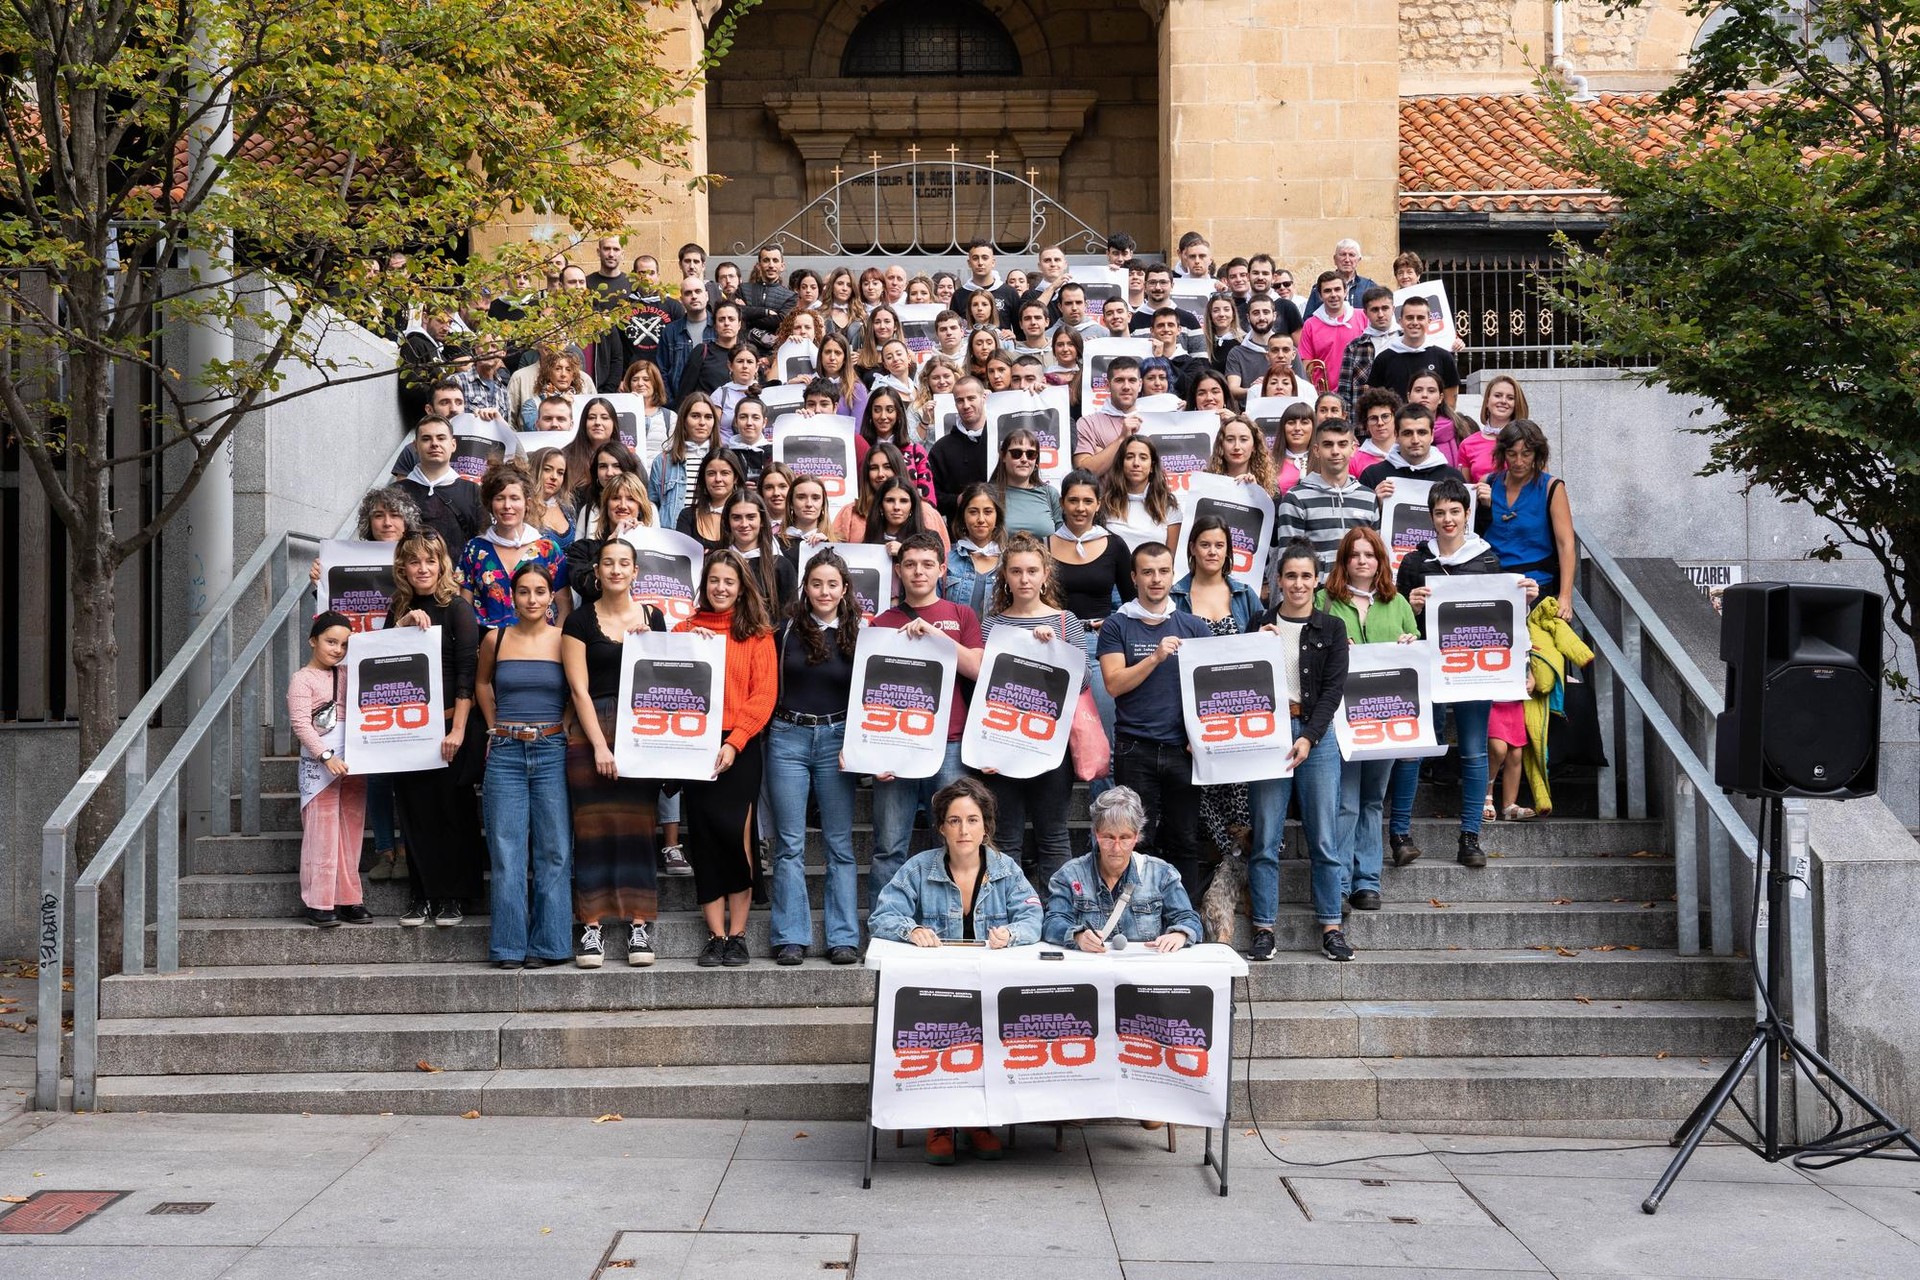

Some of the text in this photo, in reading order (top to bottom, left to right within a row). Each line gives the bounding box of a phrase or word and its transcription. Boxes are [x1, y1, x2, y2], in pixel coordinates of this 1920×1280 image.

[343, 590, 382, 598] GREBA
[331, 604, 387, 612] OROKORR
[1453, 625, 1497, 634] GREBA
[1442, 632, 1509, 641] FEMINISTA
[1441, 639, 1510, 648] OROKORRA
[1441, 645, 1511, 673] 30
[373, 681, 414, 691] GREBA
[648, 687, 693, 696] GREBA
[879, 683, 923, 695] GREBA
[1004, 682, 1048, 699] GREBA
[361, 687, 426, 699] FEMINISTA
[635, 693, 706, 703] FEMINISTA
[866, 688, 935, 703] FEMINISTA
[990, 685, 1058, 710] FEMINISTA
[1211, 689, 1257, 700] GREBA
[360, 695, 427, 706] OROKORRA
[634, 700, 706, 711] OROKORRA
[864, 696, 935, 711] OROKORRA
[988, 693, 1057, 717] OROKORRA
[1199, 695, 1271, 708] FEMINISTA
[1359, 695, 1403, 706] GREBA
[1200, 702, 1272, 716] OROKORRA
[1348, 701, 1415, 714] FEMINISTA
[359, 701, 430, 732] 30
[861, 703, 935, 736] 30
[981, 699, 1057, 741] 30
[1348, 708, 1416, 721] OROKORRA
[631, 706, 707, 737] 30
[1199, 709, 1276, 742] 30
[1349, 714, 1420, 745] 30
[1018, 1012, 1076, 1023] GREBA
[1135, 1013, 1190, 1028] GREBA
[914, 1021, 970, 1032] GREBA
[1003, 1020, 1093, 1031] FEMINISTA
[1119, 1017, 1207, 1038] FEMINISTA
[897, 1026, 983, 1040] FEMINISTA
[1002, 1028, 1094, 1039] OROKORRA
[1118, 1025, 1207, 1047] OROKORRA
[896, 1034, 982, 1049] OROKORRA
[1002, 1035, 1097, 1070] 30
[1117, 1033, 1209, 1078] 30
[893, 1042, 984, 1079] 30
